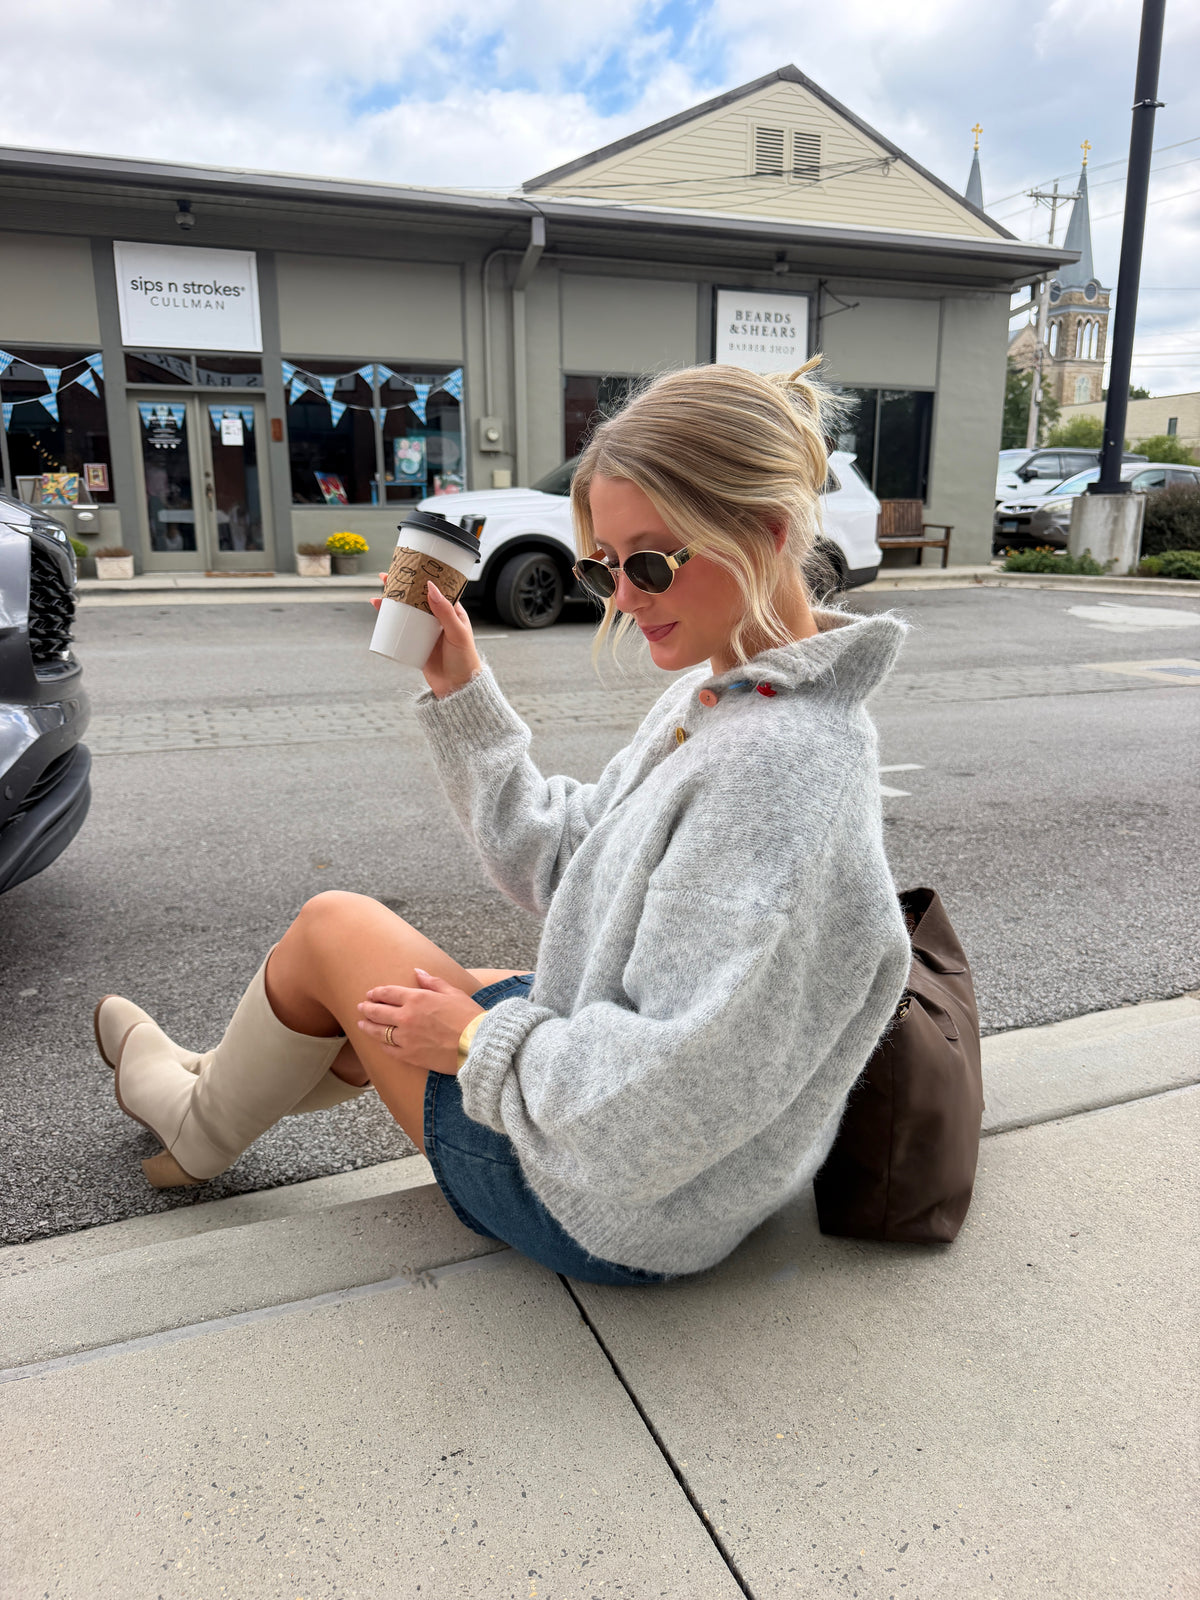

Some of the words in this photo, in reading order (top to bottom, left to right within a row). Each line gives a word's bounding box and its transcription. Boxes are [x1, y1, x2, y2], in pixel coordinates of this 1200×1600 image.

[130, 276, 163, 295] sips
[168, 281, 178, 293] n
[150, 296, 225, 310] CULLMAN
[735, 310, 792, 325] BEARDS
[729, 324, 796, 338] &SHEARS
